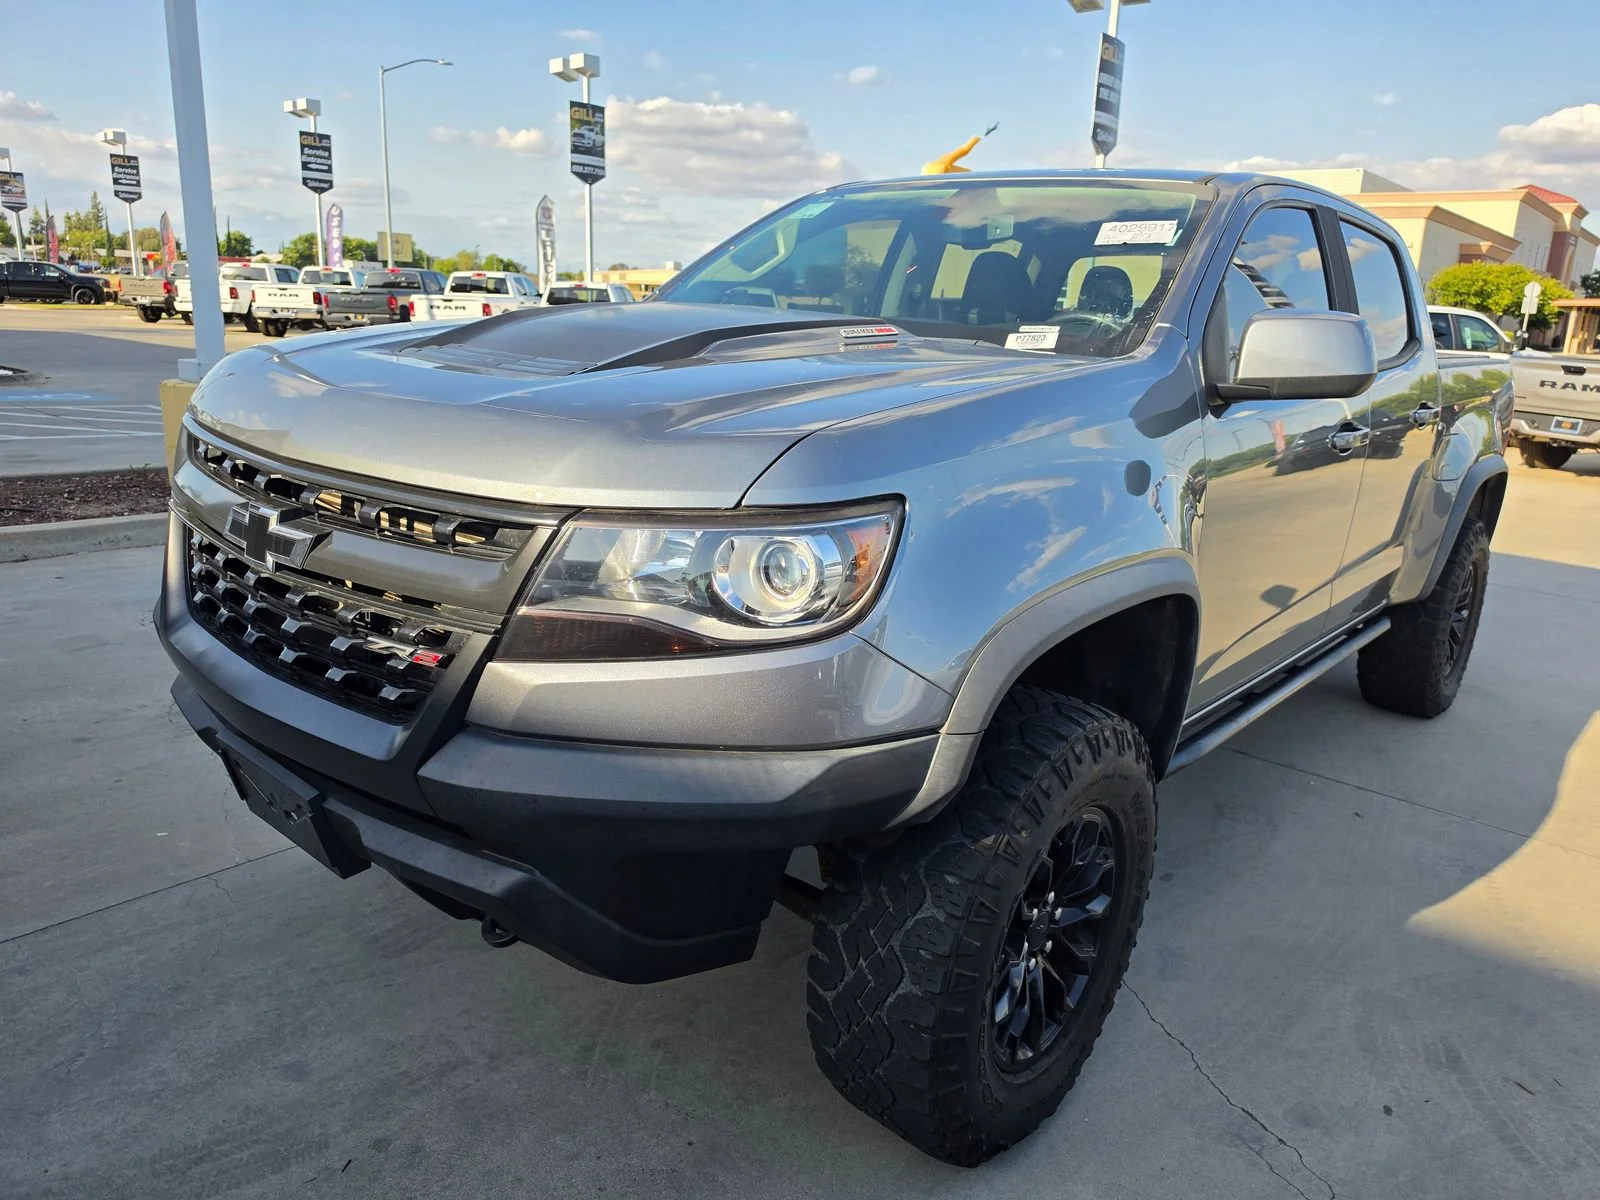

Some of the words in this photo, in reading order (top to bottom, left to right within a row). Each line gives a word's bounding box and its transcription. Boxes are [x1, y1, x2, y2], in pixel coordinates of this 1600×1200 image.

[571, 106, 593, 121] GILL
[300, 135, 320, 146] GILL
[303, 147, 330, 157] Service
[1108, 223, 1176, 233] 4029917
[1015, 334, 1047, 342] P77823
[1540, 380, 1600, 393] RAM
